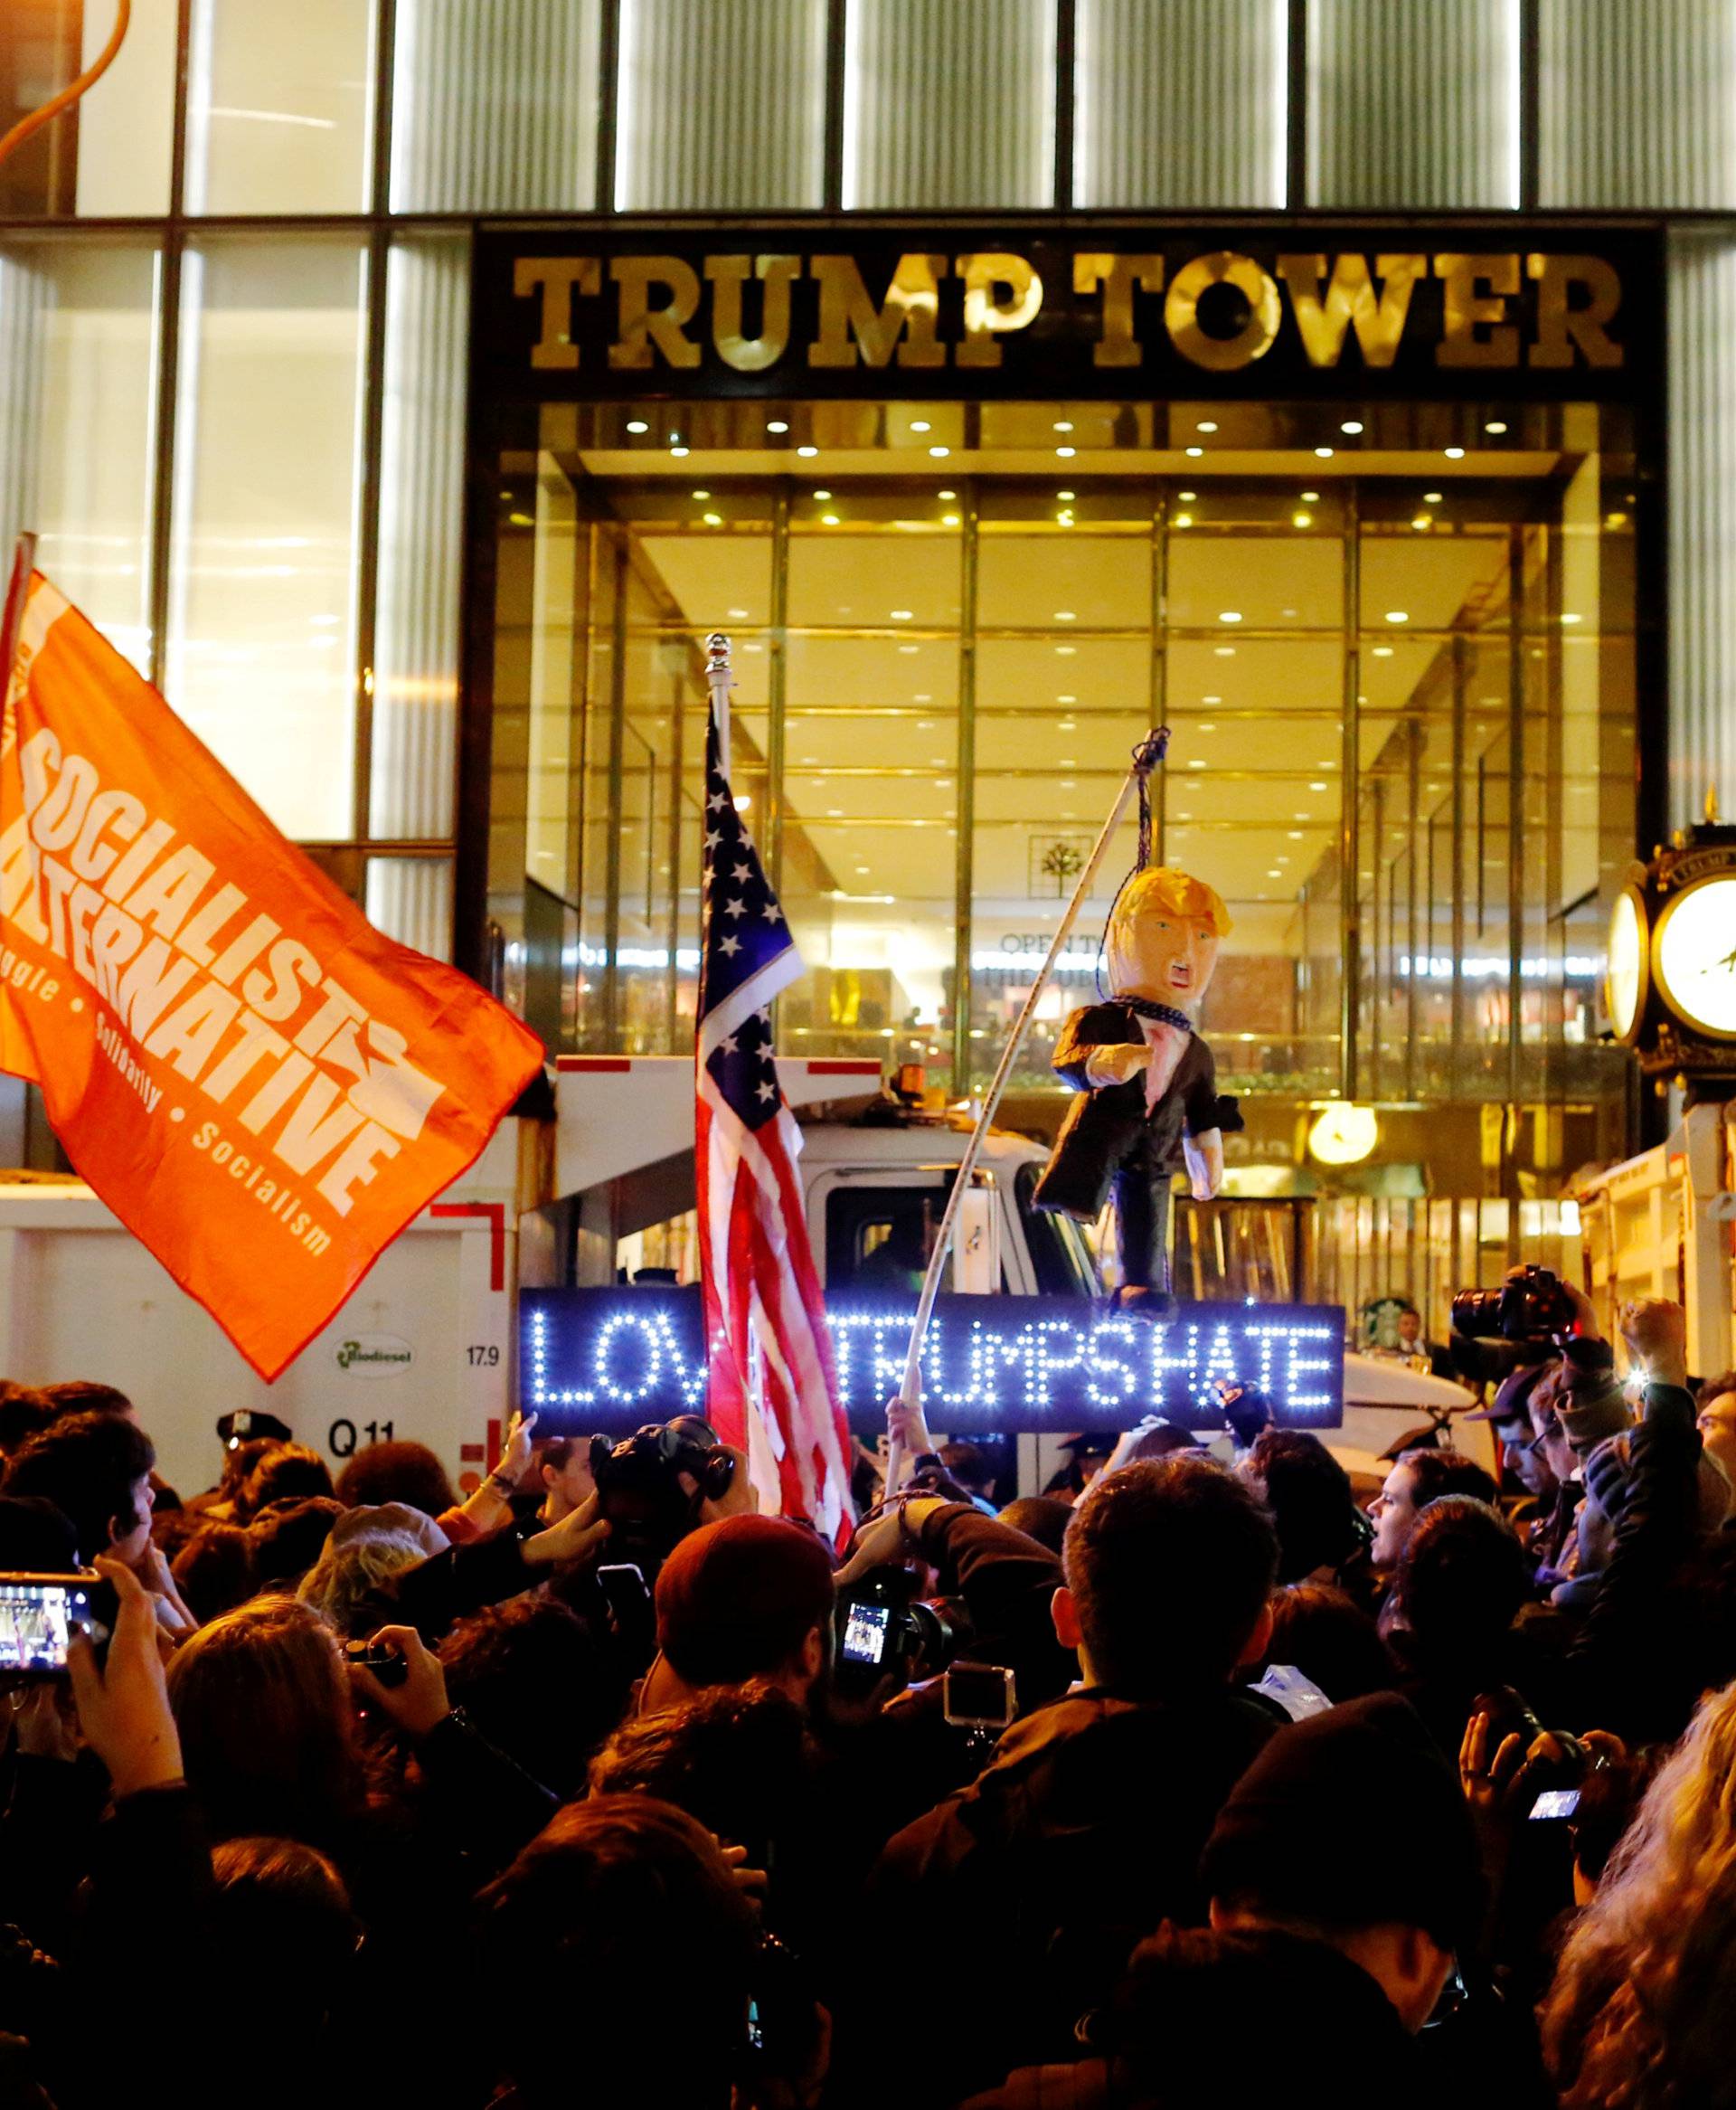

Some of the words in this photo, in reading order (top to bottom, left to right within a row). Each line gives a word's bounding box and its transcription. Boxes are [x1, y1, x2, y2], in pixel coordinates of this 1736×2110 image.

[514, 252, 1043, 371] TRUMP
[1073, 251, 1623, 371] TOWER
[20, 727, 371, 1058] SOCIALIST
[0, 812, 401, 1217] ALTERNATIVE
[193, 1121, 332, 1257] Socialism
[348, 1350, 411, 1362] Biodiesel
[467, 1345, 500, 1366] 17.9
[1150, 1320, 1333, 1407] HATE
